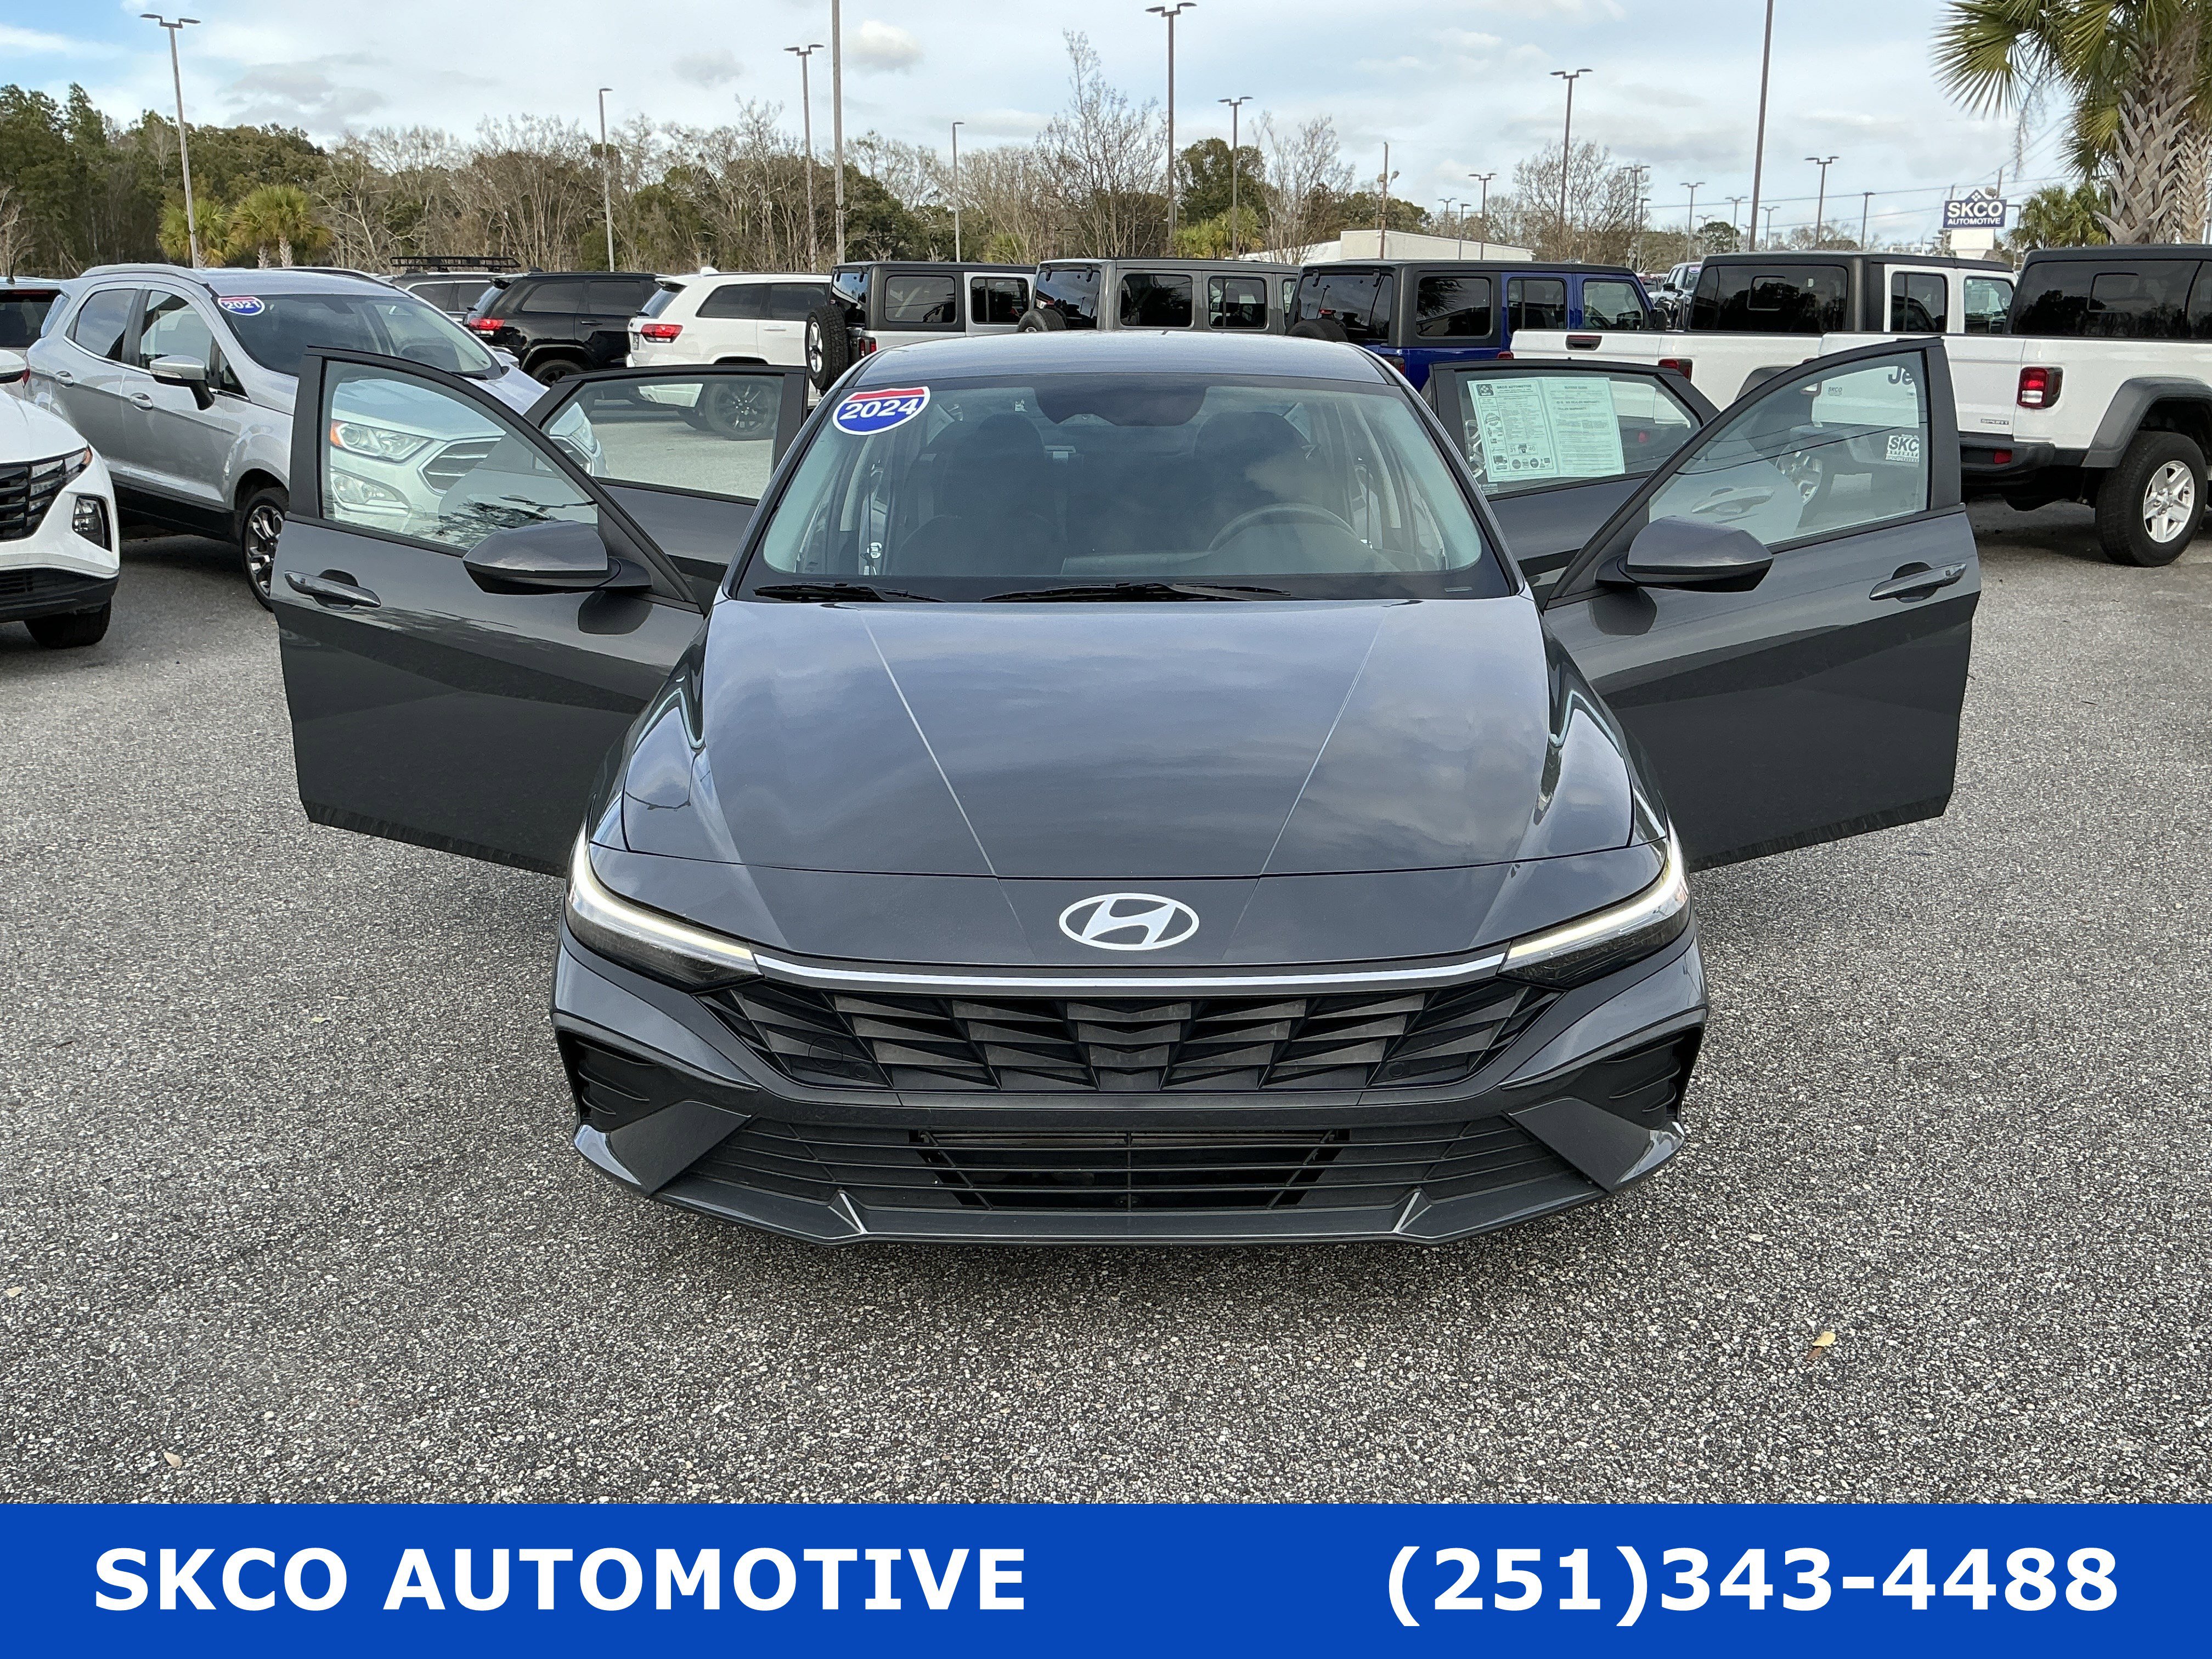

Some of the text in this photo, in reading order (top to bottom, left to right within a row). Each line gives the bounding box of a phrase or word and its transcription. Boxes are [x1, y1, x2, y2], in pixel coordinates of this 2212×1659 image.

[1947, 201, 2003, 218] SKCO
[224, 300, 261, 309] 2021
[839, 398, 919, 420] 2024
